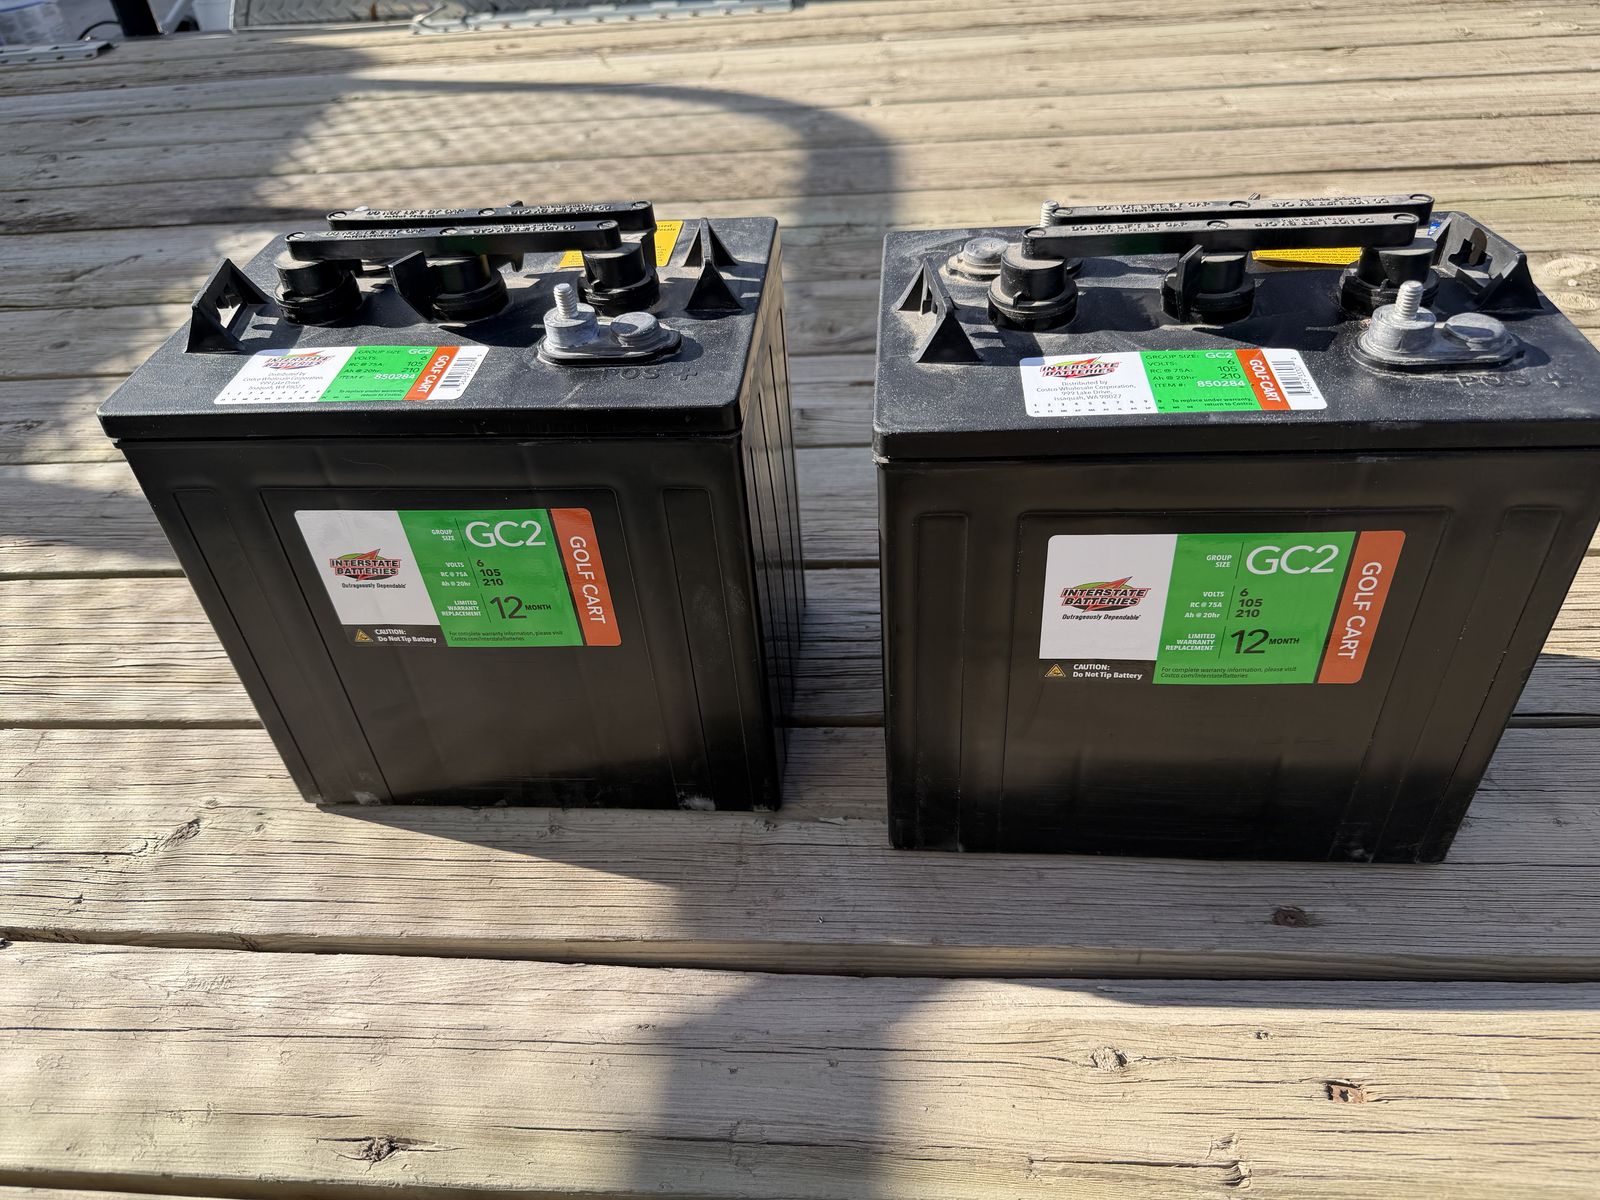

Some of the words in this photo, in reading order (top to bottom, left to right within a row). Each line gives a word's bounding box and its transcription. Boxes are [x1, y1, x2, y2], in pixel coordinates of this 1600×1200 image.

[430, 354, 450, 375] GOLF
[1041, 362, 1118, 371] INTERSTATE
[1044, 368, 1114, 376] BATTERIES
[1249, 359, 1270, 380] GOLF
[417, 375, 437, 393] CART
[1259, 381, 1281, 402] CART
[465, 520, 546, 547] GC2
[570, 536, 595, 580] GOLF
[1246, 544, 1339, 575] GC2
[476, 559, 485, 567] 6
[336, 567, 397, 575] BATTERIES
[480, 568, 501, 577] 105
[483, 578, 504, 586] 210
[1353, 561, 1382, 611] GOLF
[1063, 589, 1146, 597] INTERSTATE
[1239, 588, 1249, 597] 6
[582, 584, 606, 624] CART
[1064, 597, 1139, 605] BATTERIES
[1239, 598, 1263, 607] 105
[490, 596, 527, 619] 12
[1235, 609, 1260, 618] 210
[412, 636, 437, 644] Battery
[1231, 628, 1269, 654] 12
[1337, 615, 1366, 660] CART
[1113, 672, 1142, 680] Battery
